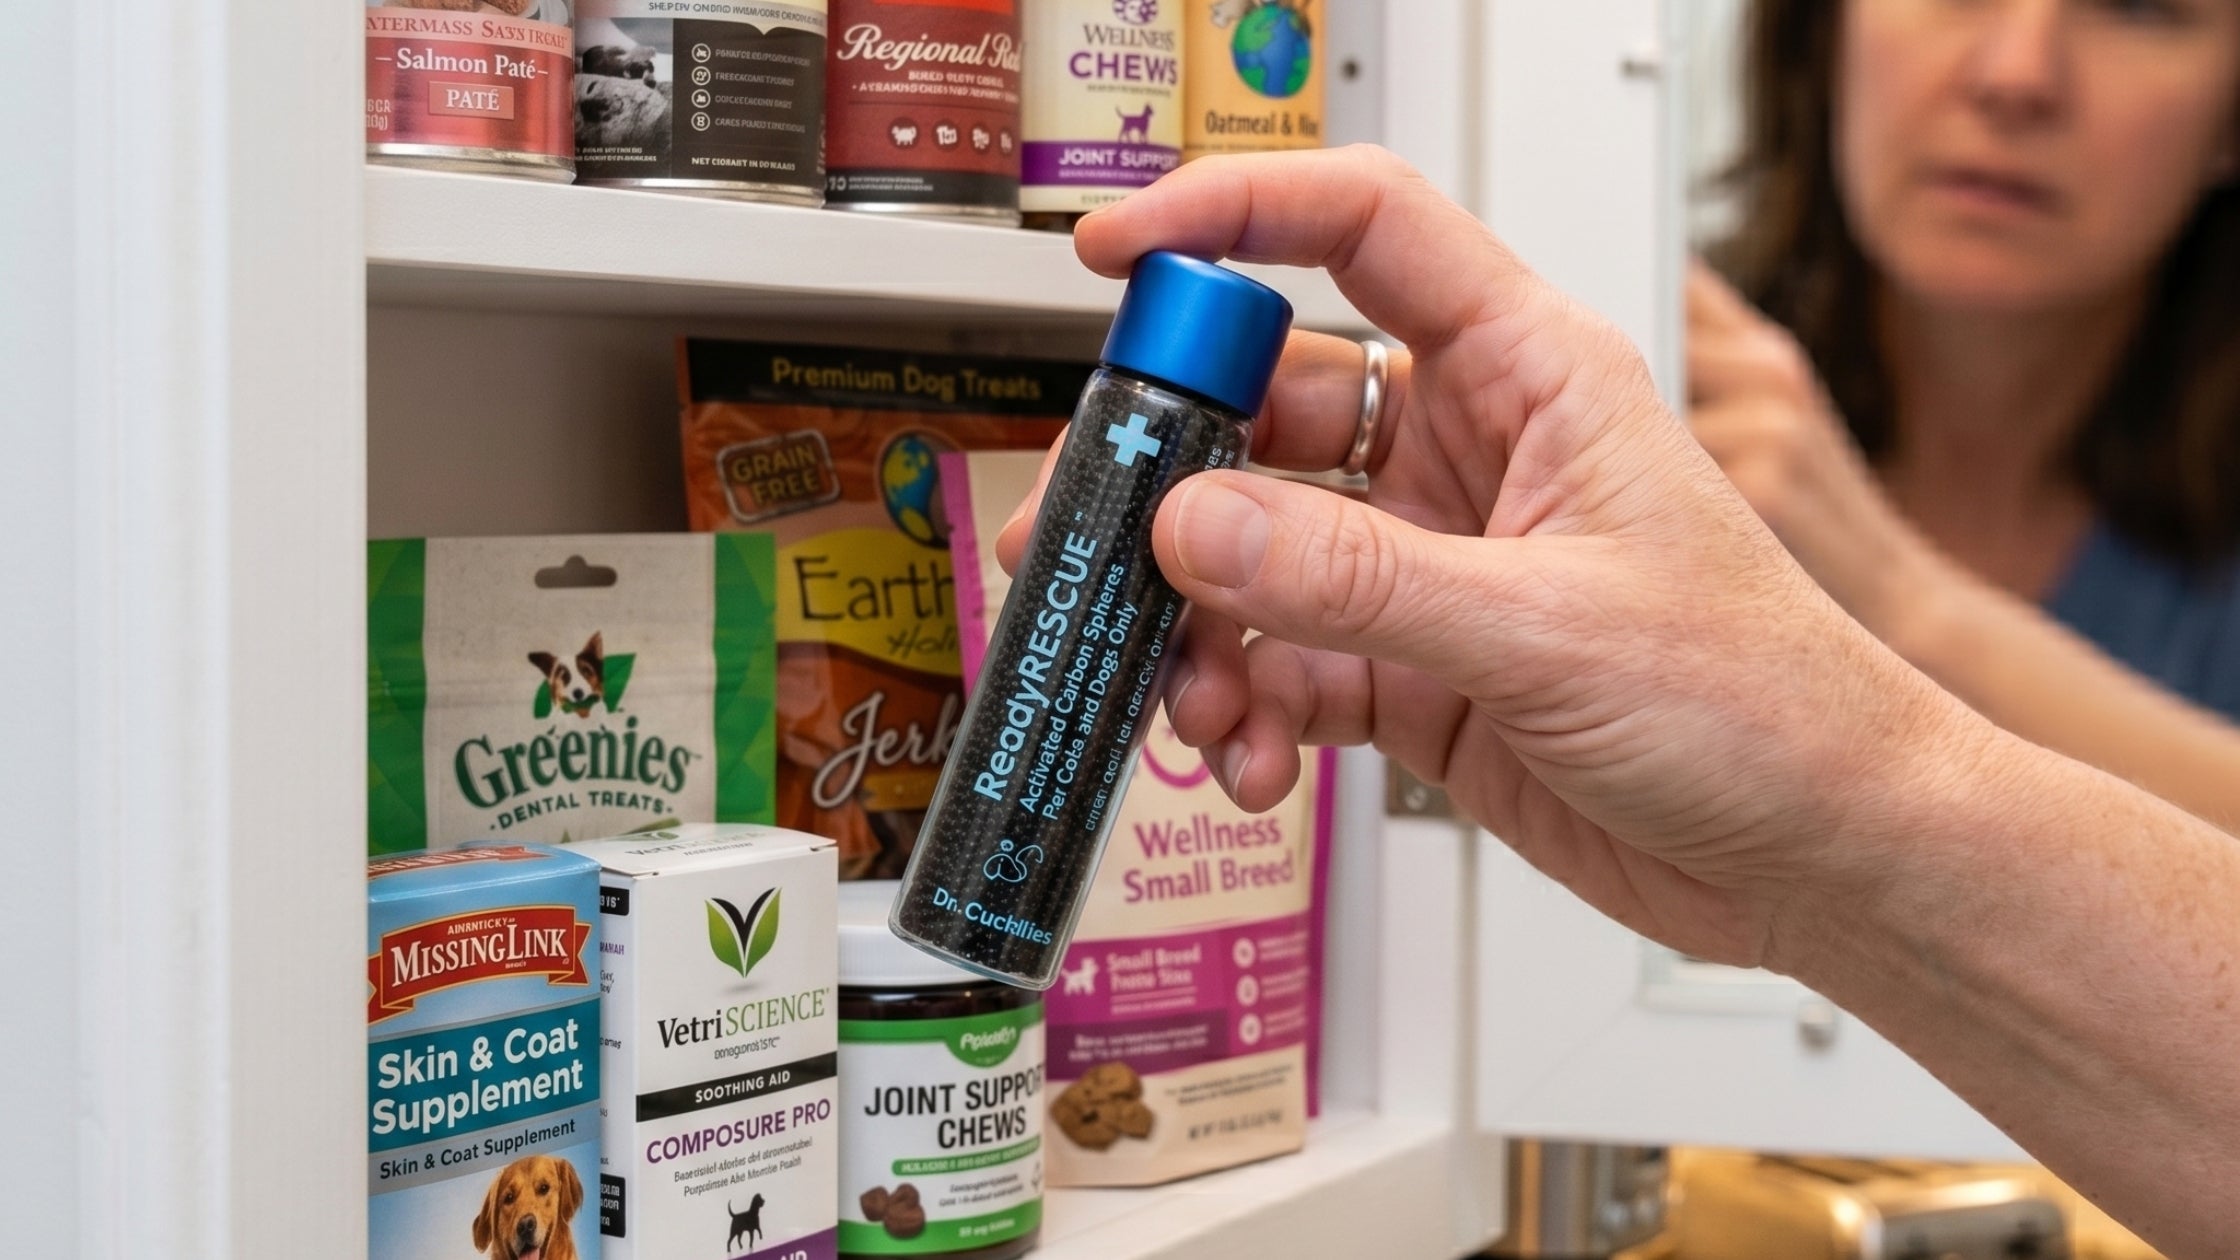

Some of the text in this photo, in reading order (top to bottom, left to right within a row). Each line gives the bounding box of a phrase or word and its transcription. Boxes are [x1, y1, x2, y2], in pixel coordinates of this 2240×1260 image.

[397, 48, 537, 79] Salmon Paté
[836, 24, 990, 70] Regional
[1068, 52, 1178, 85] CHEWS
[446, 88, 501, 111] PATÉ
[1205, 112, 1275, 136] Oatmeal
[1283, 113, 1292, 136] &
[1058, 149, 1116, 168] JOINT
[771, 357, 1041, 402] Premium Dog Treats
[732, 447, 816, 482] GRAIN
[752, 469, 820, 504] FREE
[1108, 601, 1138, 646] Only
[974, 531, 1097, 801] ReadyRESCUE
[1020, 563, 1124, 813] Activated Carbon Spheres
[454, 716, 692, 811] Greenies
[497, 791, 664, 831] DENTAL TREATS
[1134, 814, 1282, 860] Wellness
[1123, 850, 1293, 904] Small Breed
[377, 1018, 579, 1089] Skin & Coat
[372, 1059, 584, 1135] Supplement
[695, 1070, 791, 1103] SOOTHING AID
[864, 1083, 956, 1116] JOINT
[379, 1119, 576, 1180] Skin & Coat Supplement
[646, 1110, 787, 1164] COMPOSURE
[792, 1098, 831, 1128] PRO
[937, 1106, 1027, 1149] CHEWS
